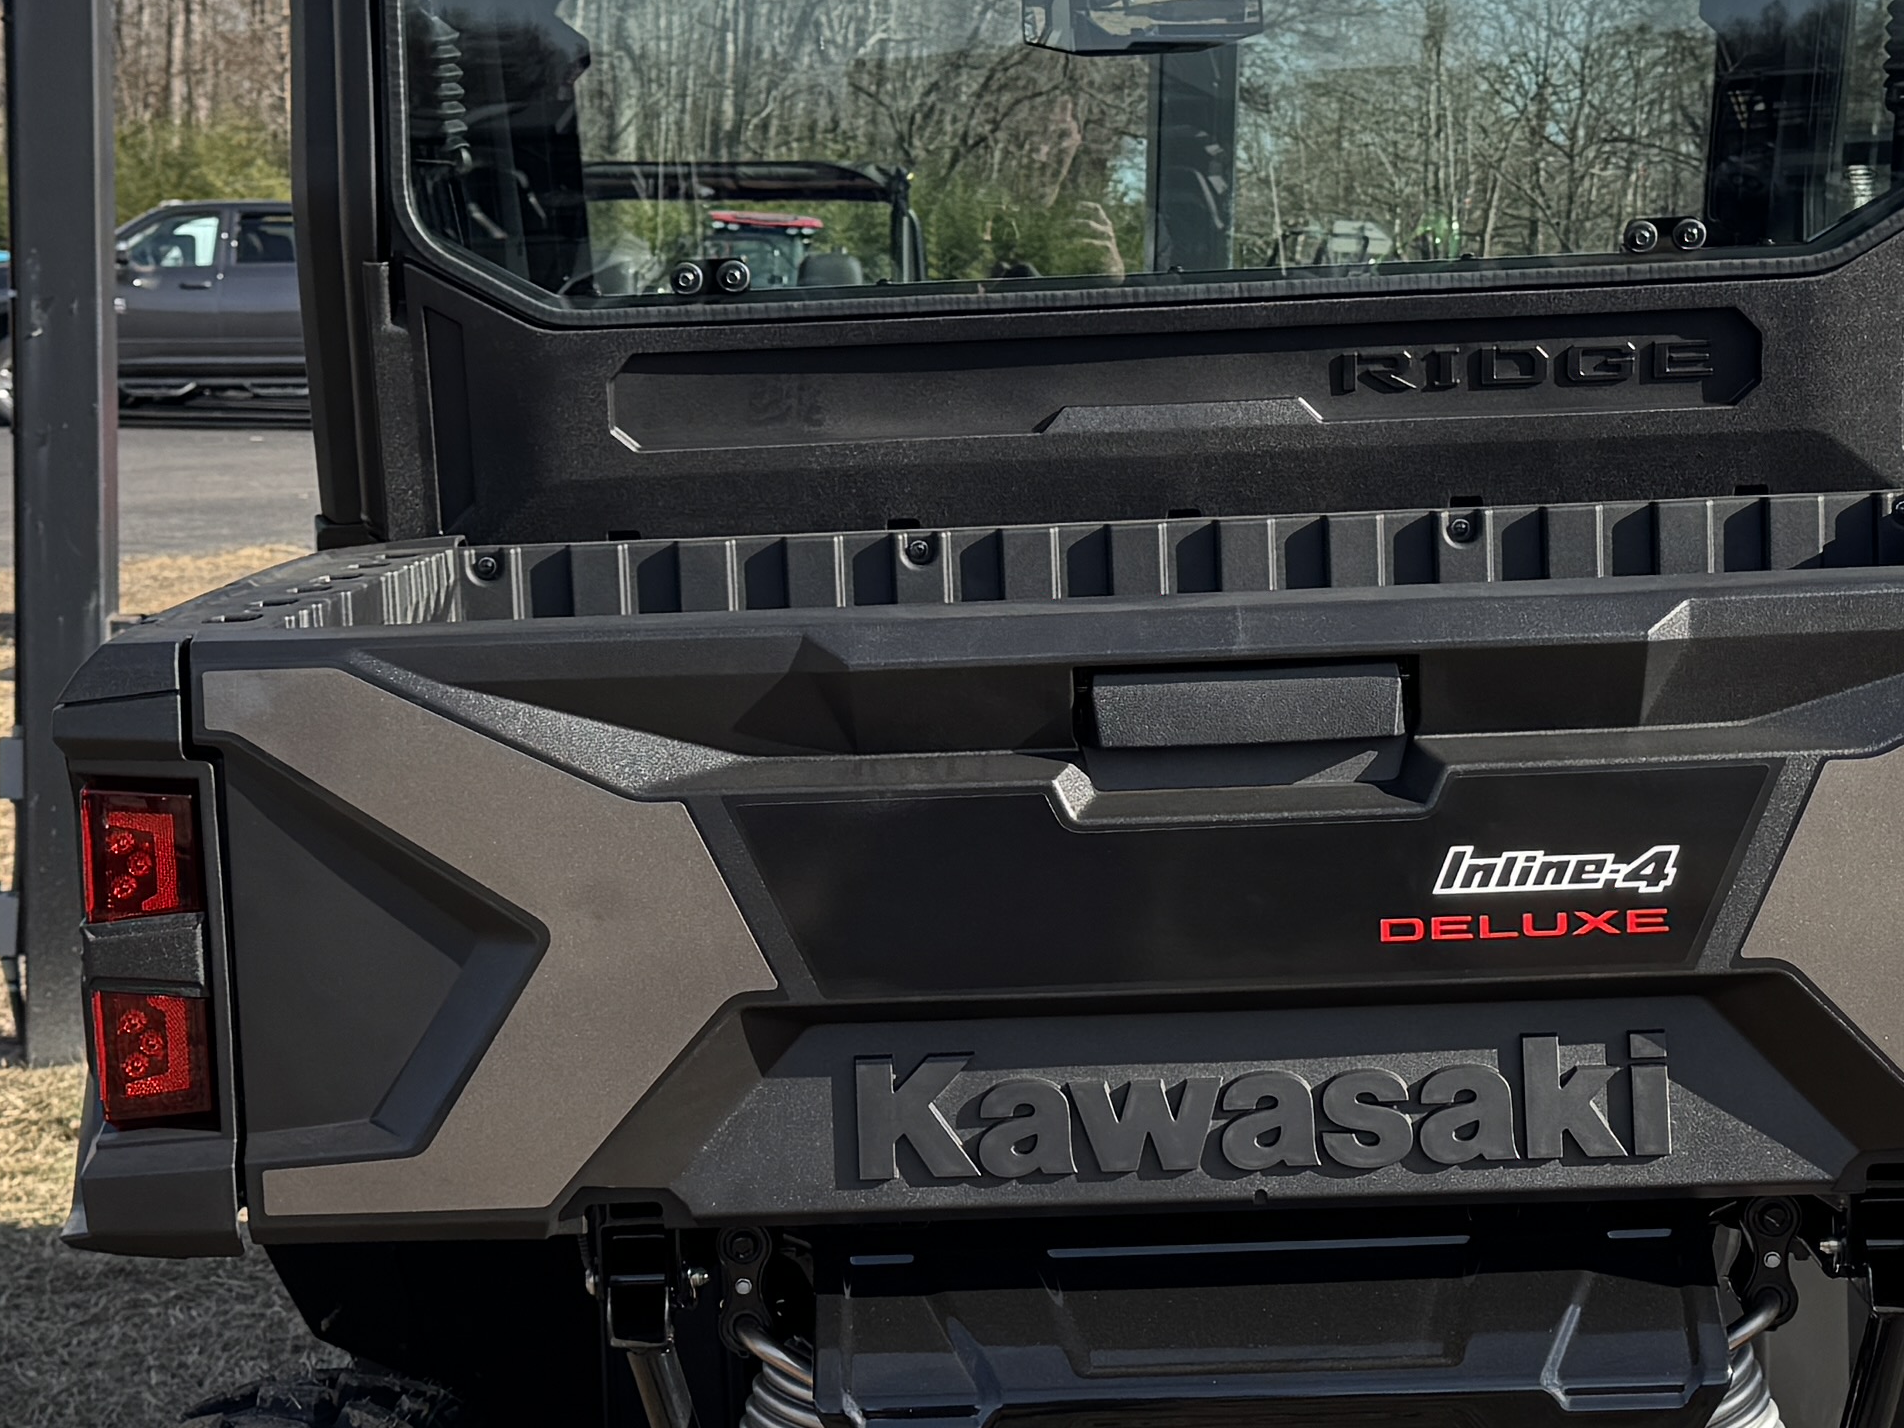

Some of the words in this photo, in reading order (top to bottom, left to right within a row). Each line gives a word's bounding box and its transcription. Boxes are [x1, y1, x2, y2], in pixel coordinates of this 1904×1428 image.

[1340, 339, 1714, 393] RIDGE
[1432, 845, 1681, 895] Inline-4
[1379, 907, 1670, 943] DELUXE
[852, 1028, 1675, 1180] Kawasaki
